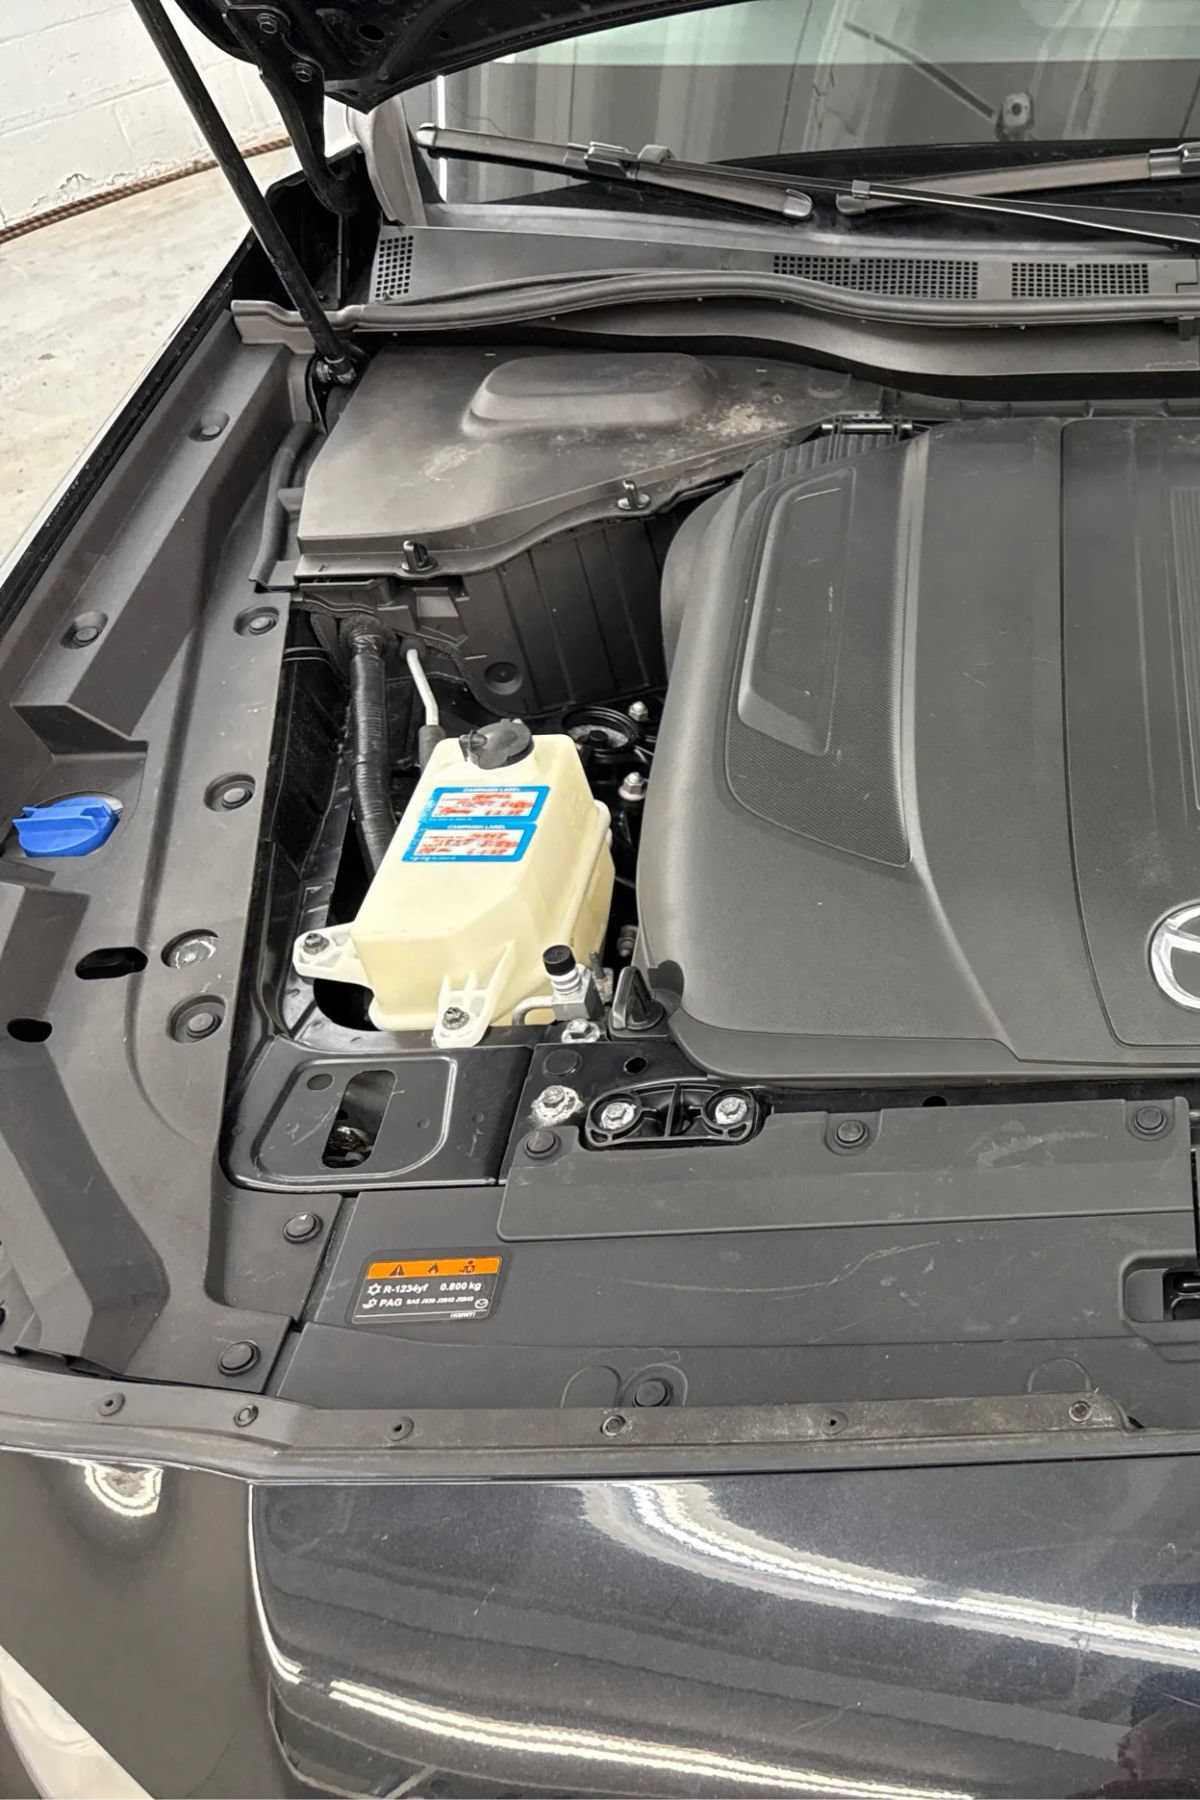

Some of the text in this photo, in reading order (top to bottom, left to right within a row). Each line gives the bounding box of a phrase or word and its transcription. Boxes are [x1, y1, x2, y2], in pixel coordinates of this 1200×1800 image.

[383, 1281, 482, 1295] R-1234yf 0.800 kg
[378, 1298, 402, 1307] PAG
